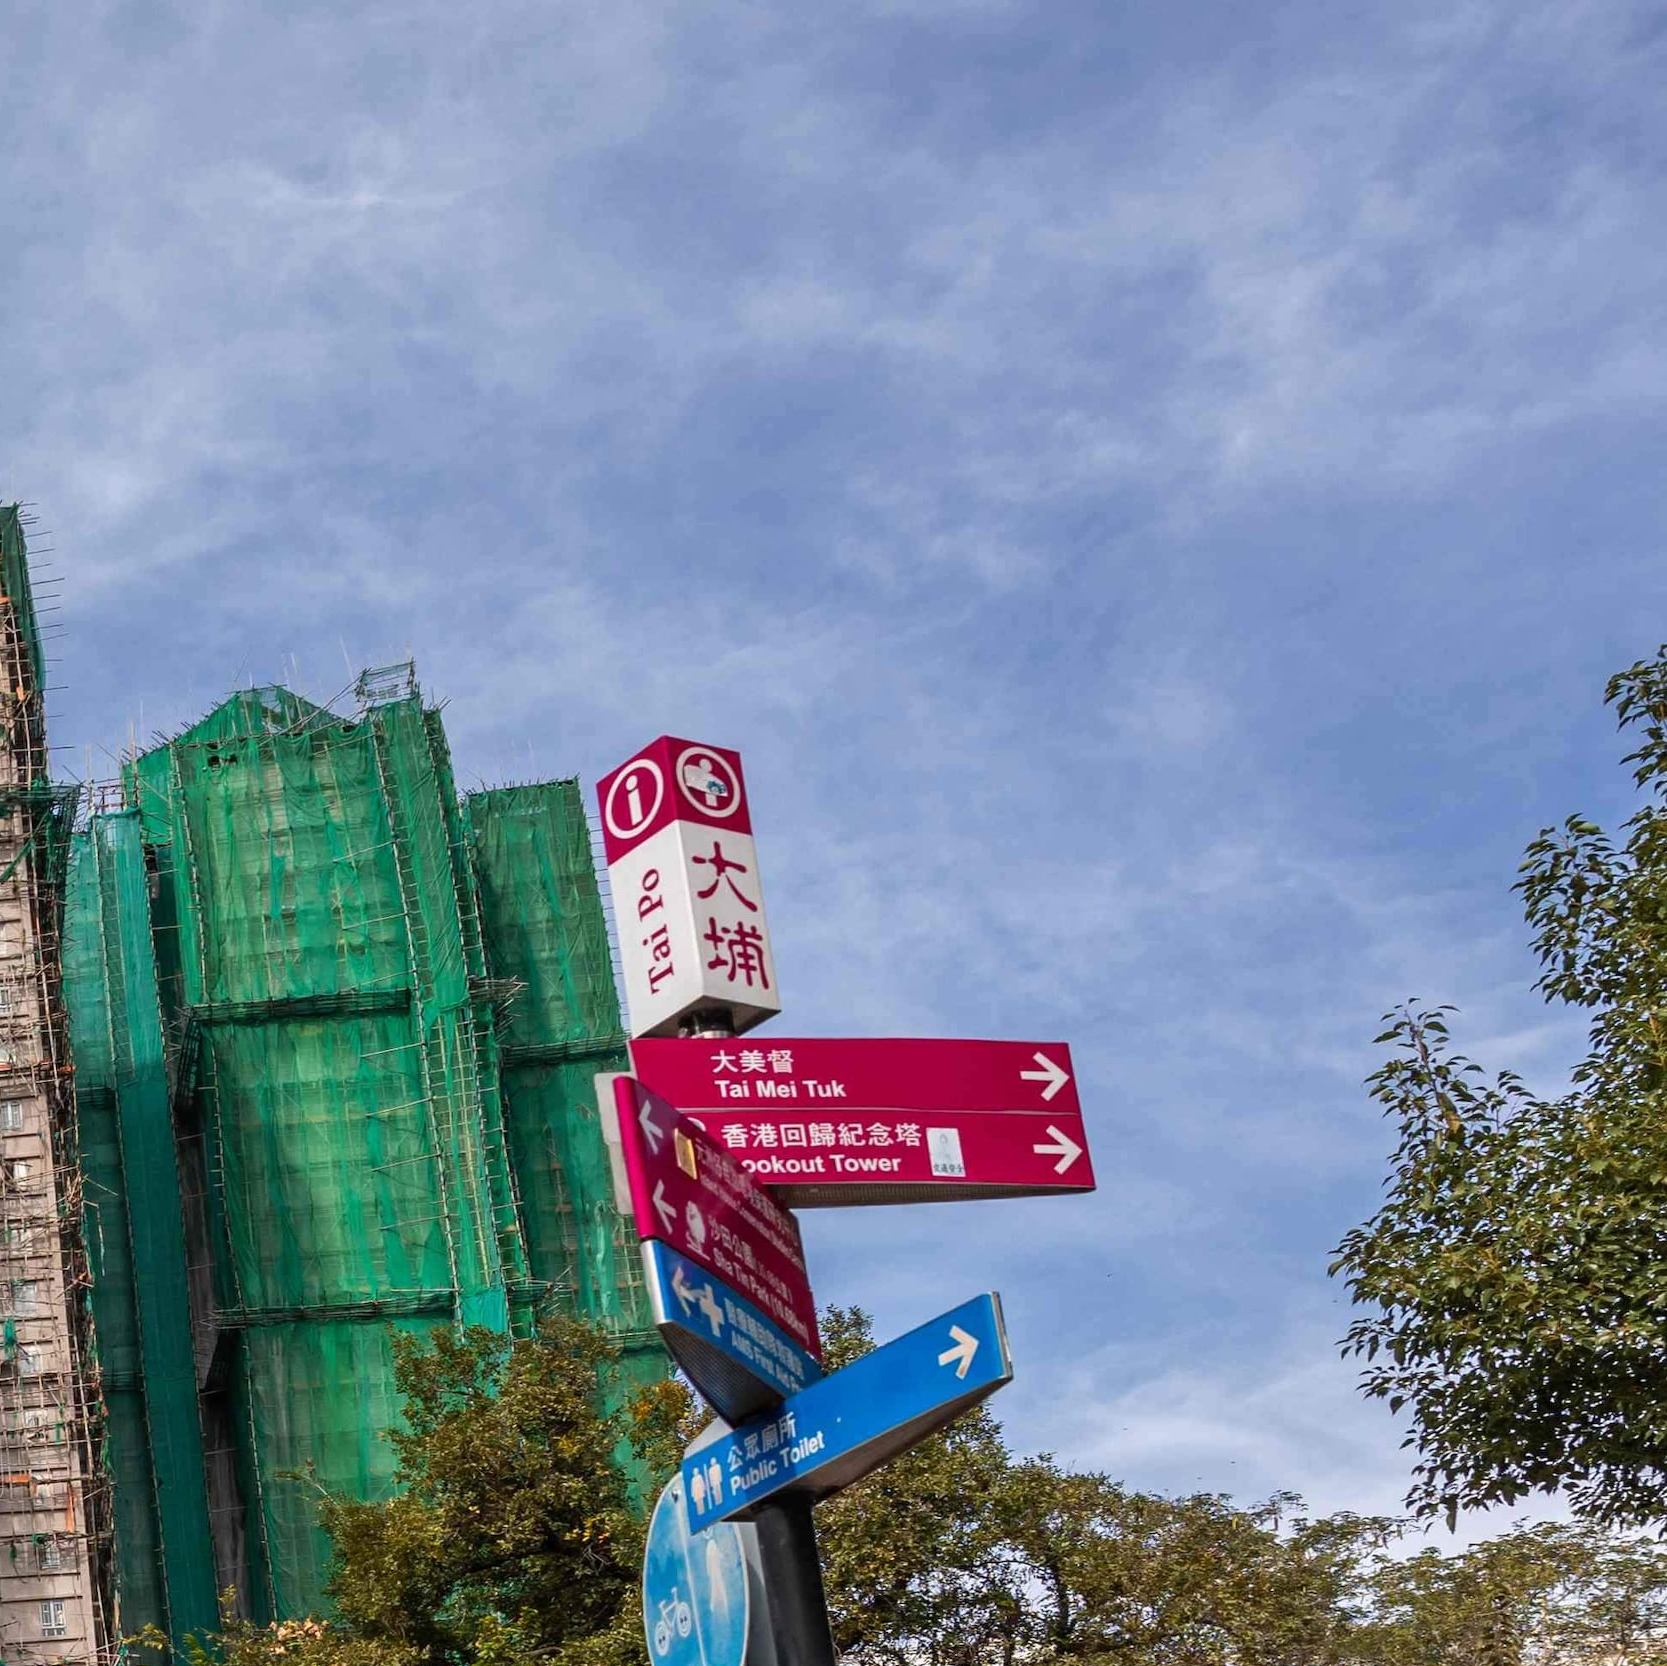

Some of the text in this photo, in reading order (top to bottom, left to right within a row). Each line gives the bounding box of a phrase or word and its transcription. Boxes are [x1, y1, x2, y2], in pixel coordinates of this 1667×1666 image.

[637, 868, 675, 995] Tai Po
[692, 841, 769, 990] 大埔
[710, 1050, 794, 1074] 大美督
[714, 1080, 847, 1098] Tai Mei Tuk
[721, 1123, 922, 1149] 香港回歸紀念塔
[742, 1154, 902, 1174] ookout Tower
[727, 1411, 796, 1472] 公眾廁所
[730, 1430, 825, 1496] Public Toilet
